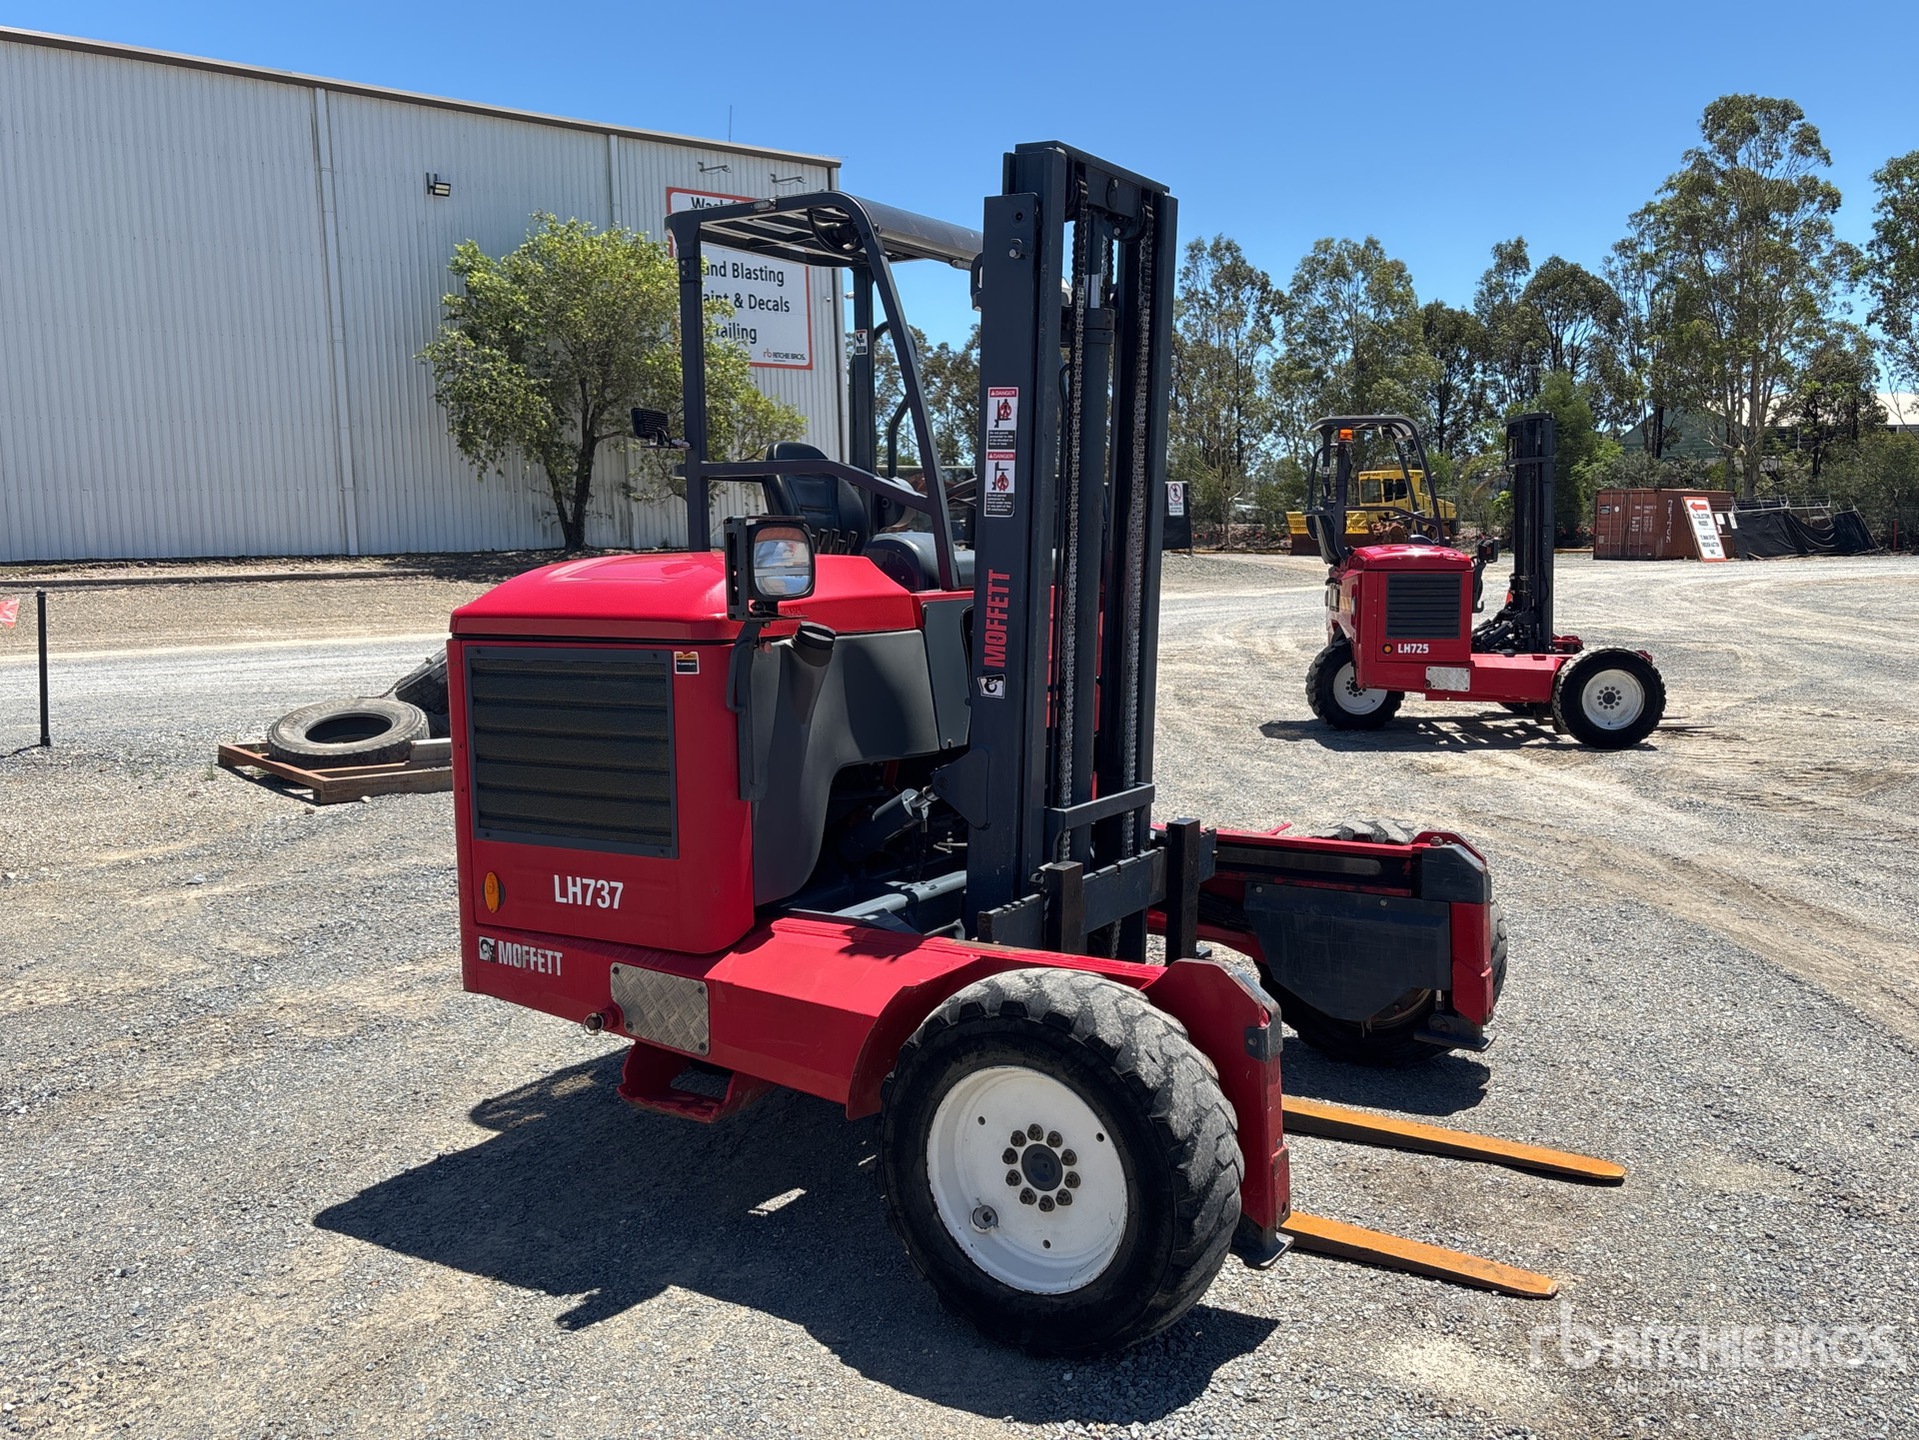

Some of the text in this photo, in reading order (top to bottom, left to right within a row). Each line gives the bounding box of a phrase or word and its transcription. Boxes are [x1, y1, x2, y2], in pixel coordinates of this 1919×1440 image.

[732, 262, 784, 287] Blasting
[703, 290, 790, 313] aint & Decals
[984, 569, 1010, 668] MOFFETT
[1397, 643, 1429, 654] LH725
[554, 874, 624, 910] LH737
[498, 940, 563, 977] MOFFETT
